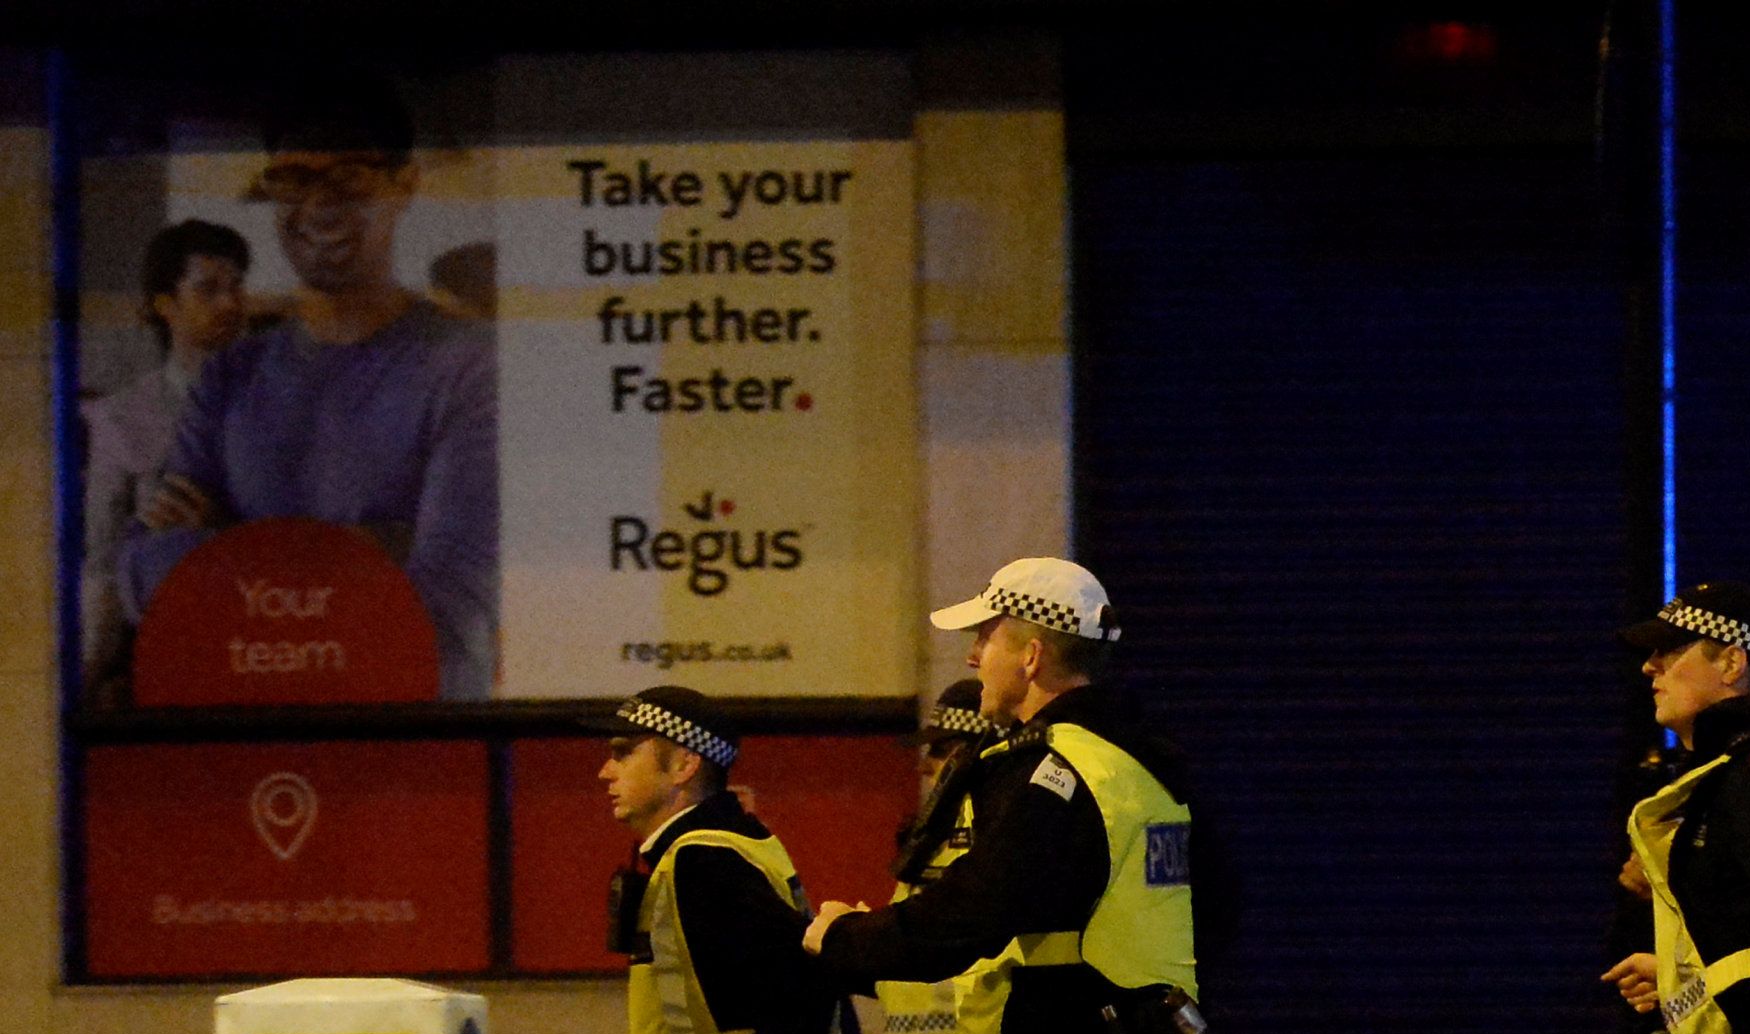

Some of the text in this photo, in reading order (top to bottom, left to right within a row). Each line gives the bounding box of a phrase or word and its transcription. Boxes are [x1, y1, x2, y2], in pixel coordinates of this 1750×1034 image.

[567, 158, 853, 219] Take your
[584, 229, 836, 275] business
[598, 296, 821, 343] further.
[611, 365, 813, 412] Faster.
[611, 515, 801, 595] Regus
[234, 578, 334, 619] Your
[227, 637, 346, 674] team
[621, 641, 792, 671] regus.co.uk
